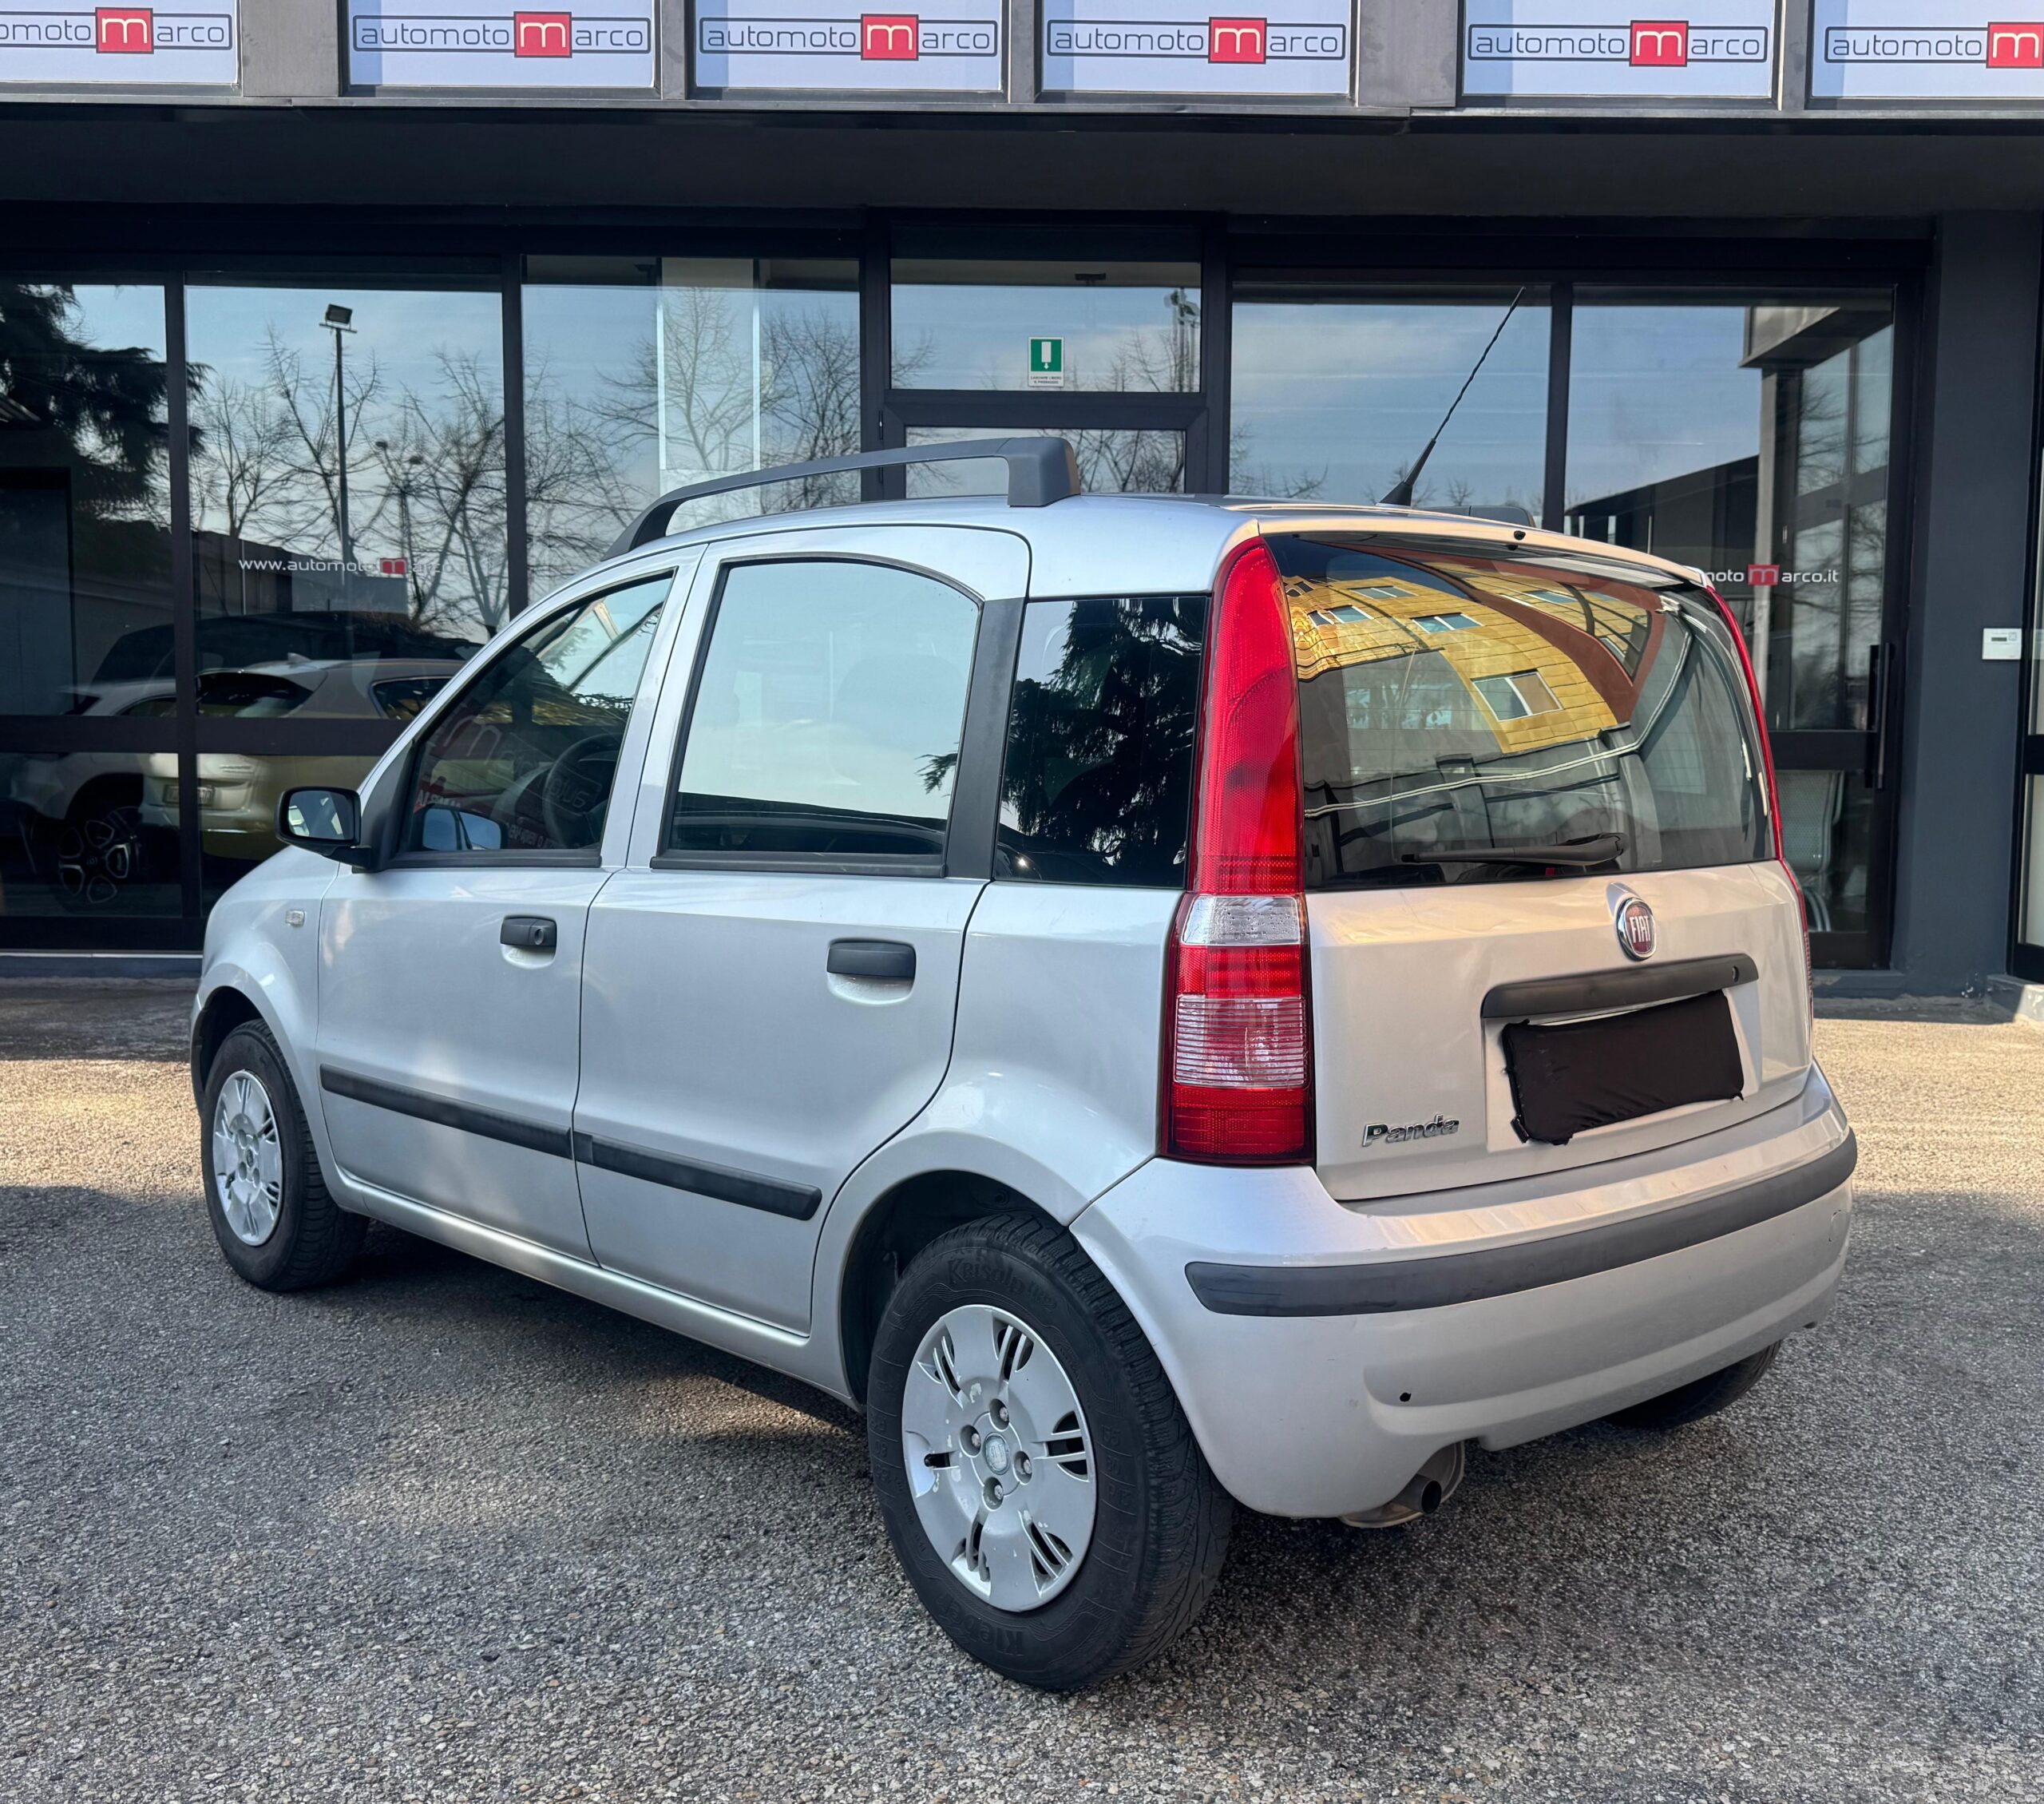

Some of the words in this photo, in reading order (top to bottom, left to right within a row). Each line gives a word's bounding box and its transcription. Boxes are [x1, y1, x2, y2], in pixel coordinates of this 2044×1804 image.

[361, 22, 510, 46] automoto
[707, 25, 857, 48] automoto
[1055, 27, 1204, 51] automoto
[1476, 32, 1626, 54] automoto
[1832, 34, 1983, 57] automoto
[1630, 916, 1651, 943] FIAT
[1361, 1112, 1460, 1148] Panda
